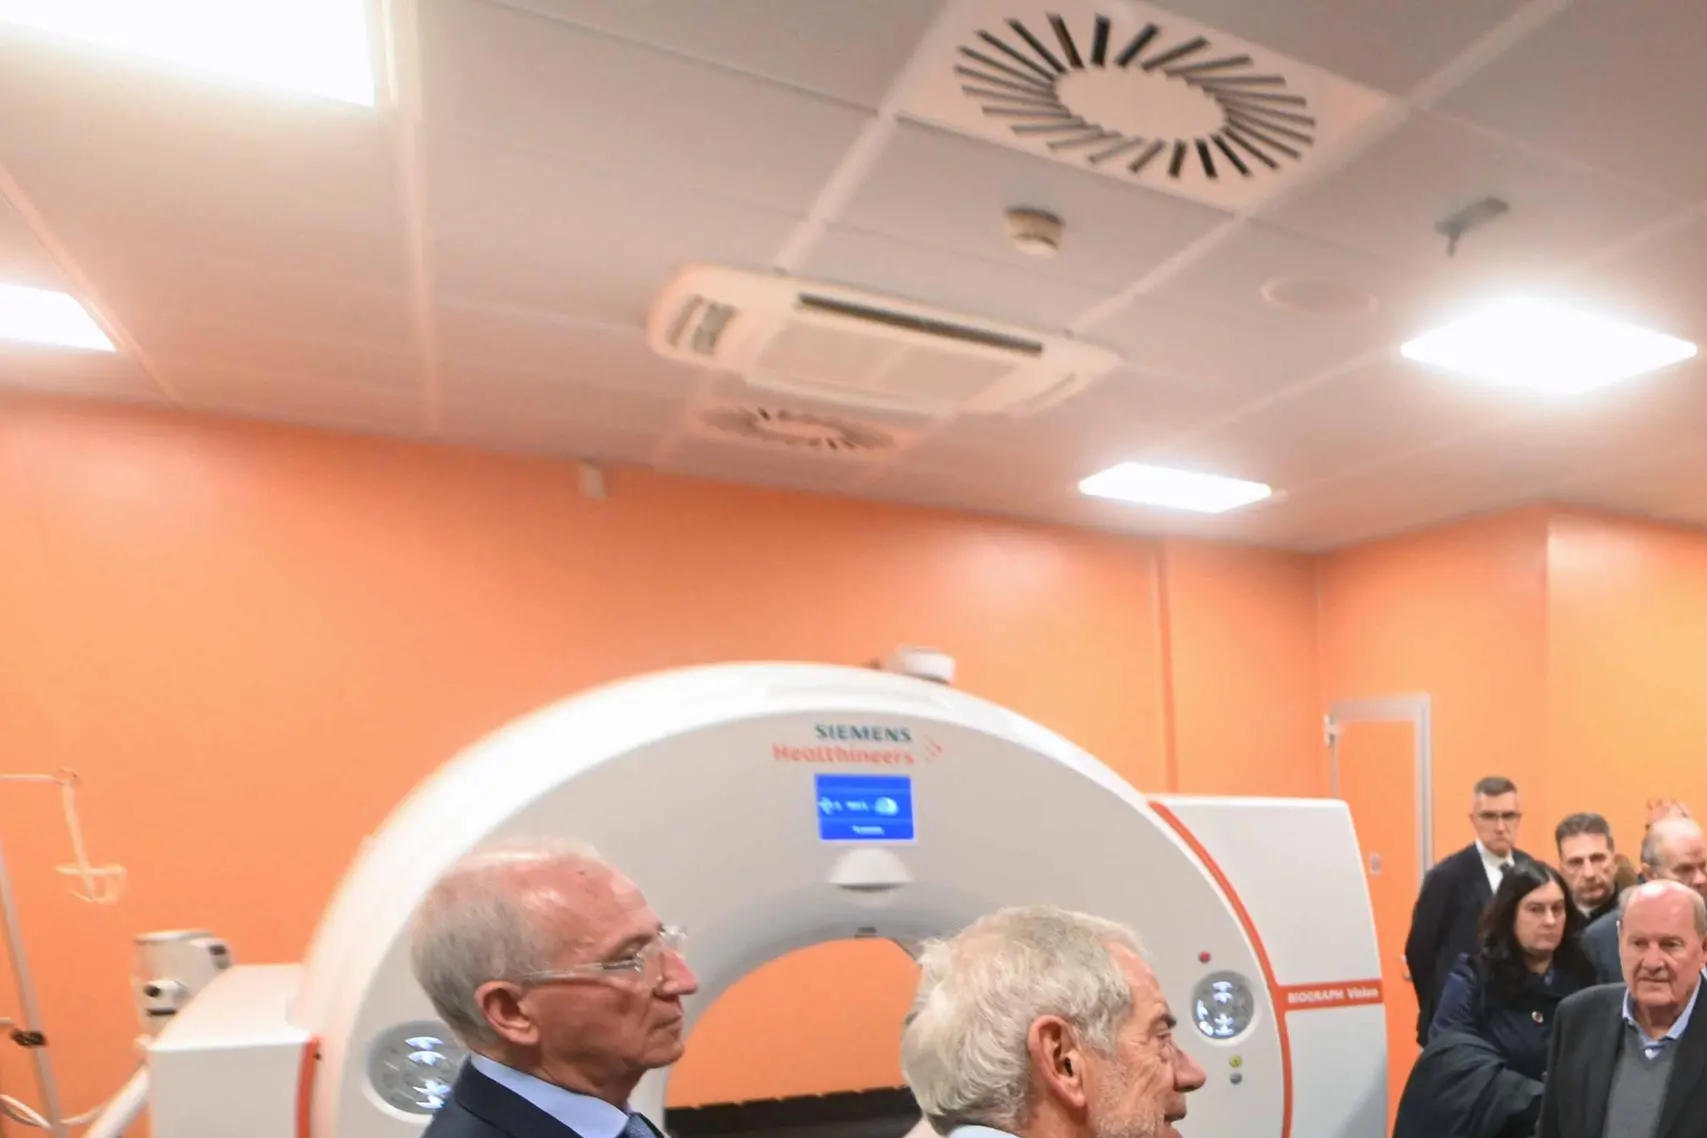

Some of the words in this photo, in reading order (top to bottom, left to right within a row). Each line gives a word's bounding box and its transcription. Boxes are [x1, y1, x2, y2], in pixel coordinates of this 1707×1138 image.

[815, 724, 912, 742] SIEMENS
[772, 744, 916, 764] Healthineers
[1287, 989, 1344, 1004] BIOGRAPH
